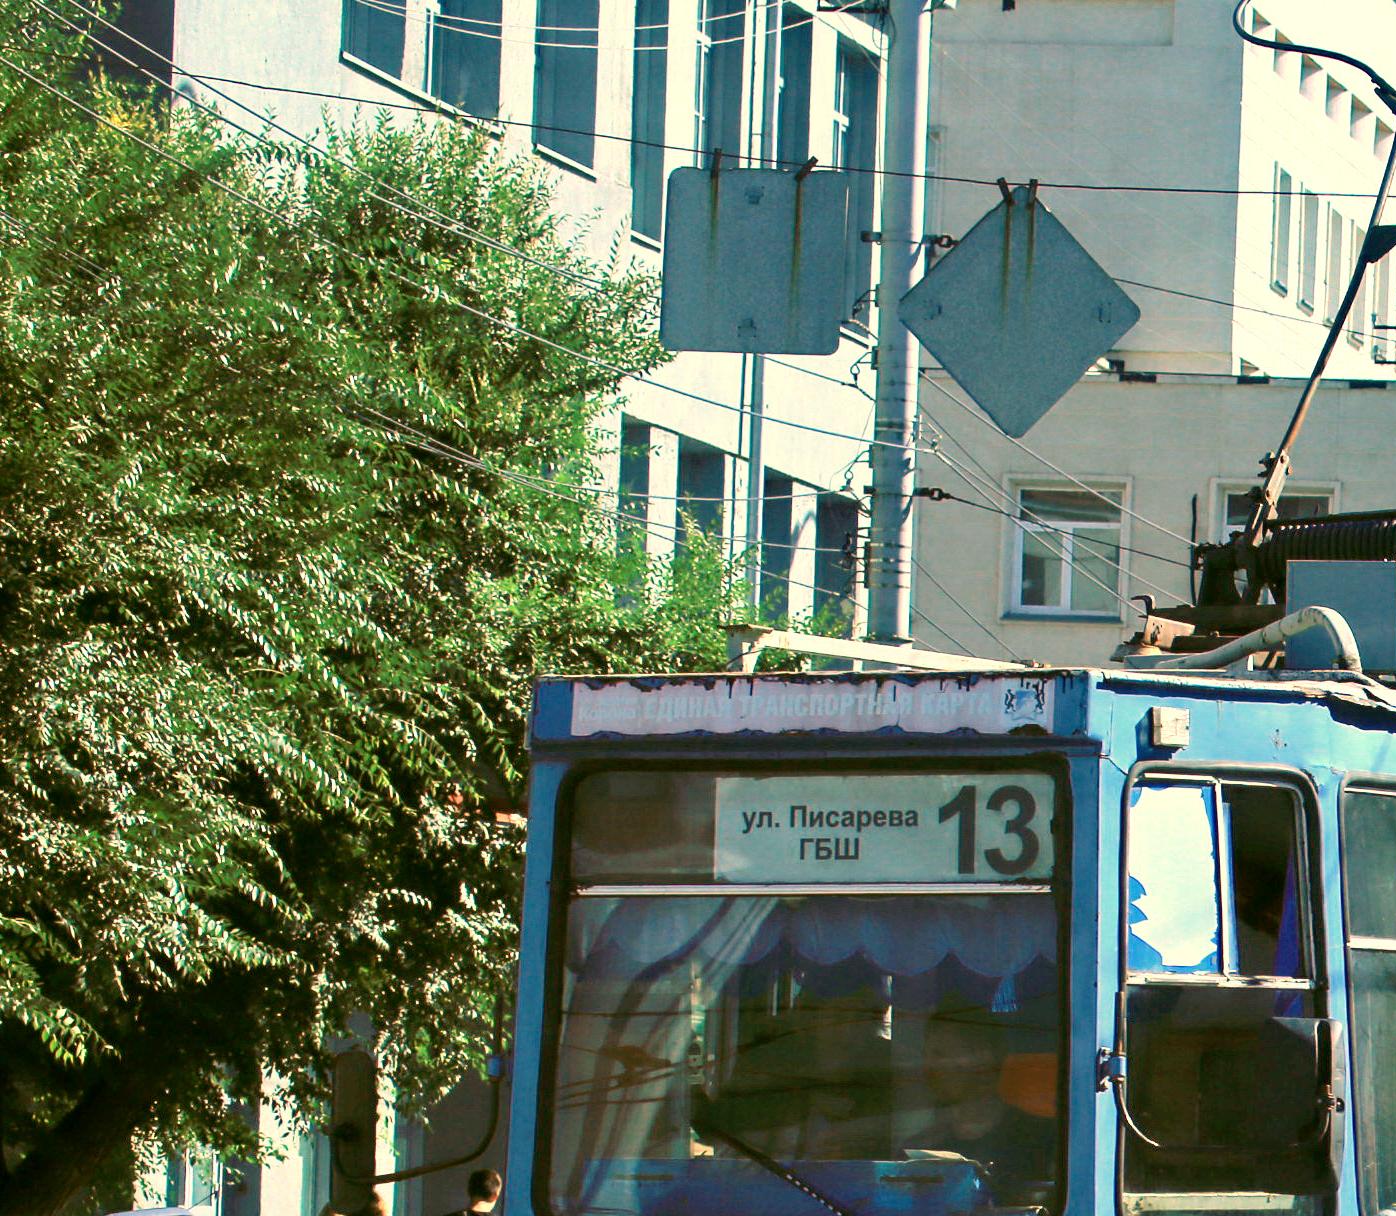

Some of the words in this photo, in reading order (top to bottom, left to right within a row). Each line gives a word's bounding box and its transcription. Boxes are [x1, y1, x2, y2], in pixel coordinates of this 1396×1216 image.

[644, 695, 730, 722] ЕДИНАЯ
[741, 693, 913, 719] ТРАНСПОРТНАЯ
[921, 691, 991, 716] КАРТА
[742, 809, 780, 833] ул.
[789, 805, 918, 832] Писарева
[938, 785, 1039, 875] 13
[799, 838, 859, 861] ГБШ
